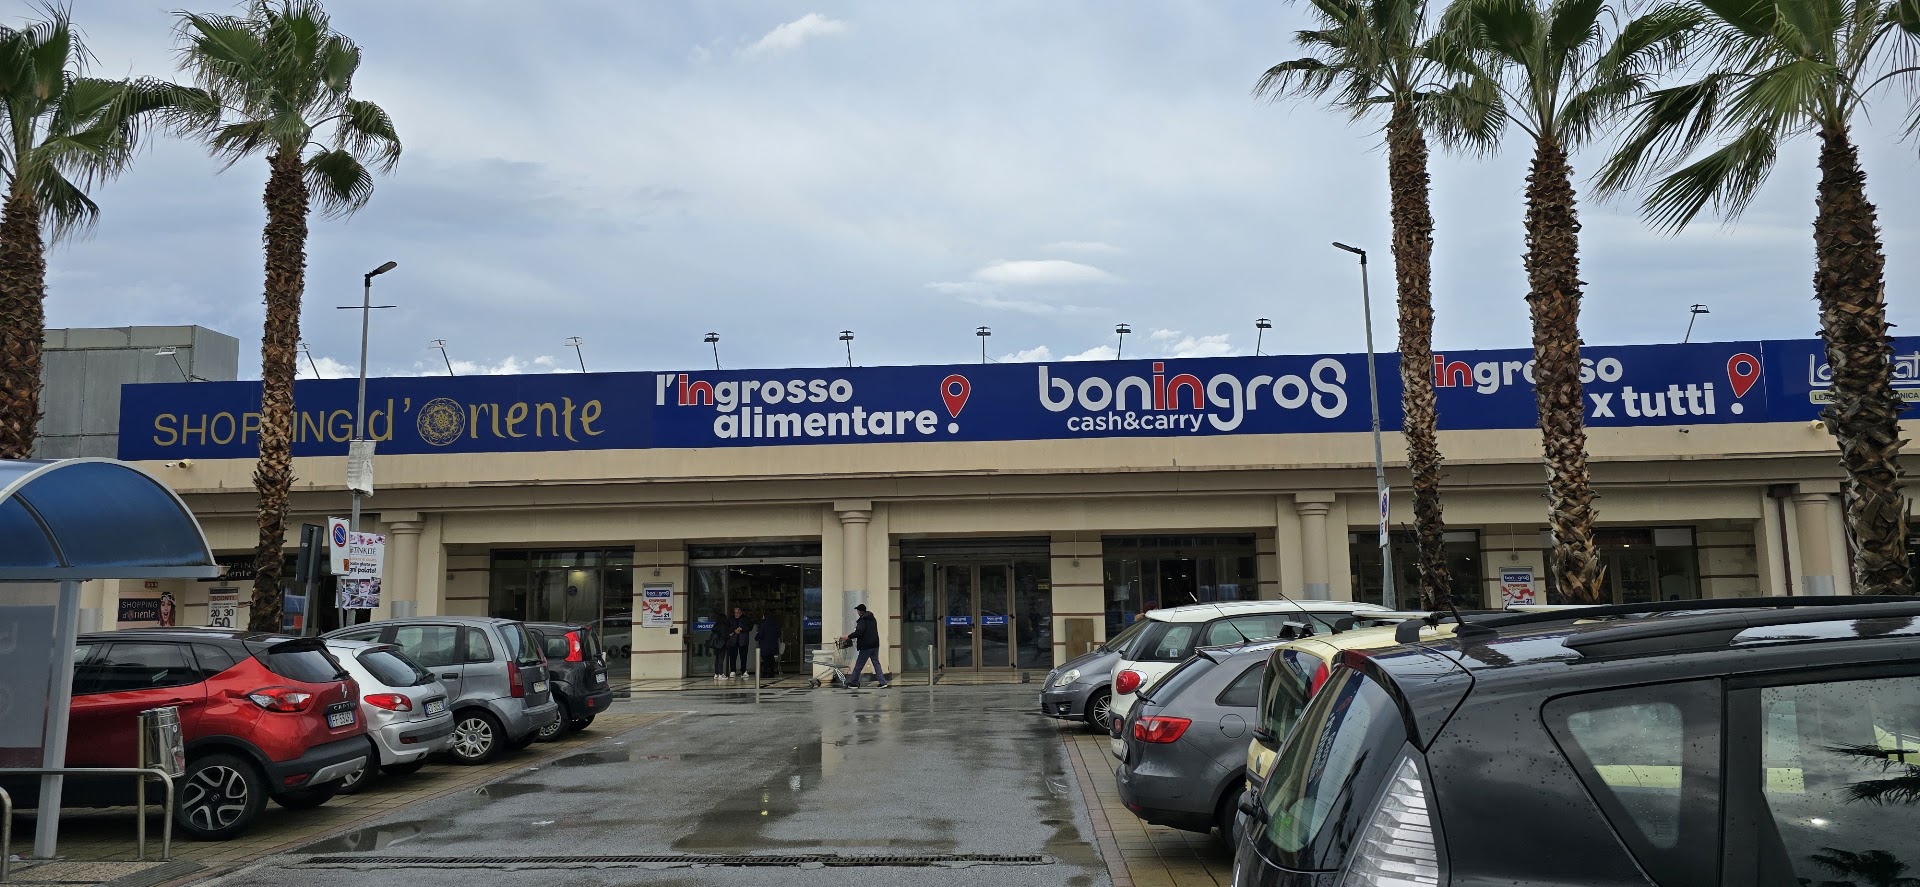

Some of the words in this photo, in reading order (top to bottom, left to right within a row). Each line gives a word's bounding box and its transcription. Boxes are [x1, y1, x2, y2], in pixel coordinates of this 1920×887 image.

[656, 373, 853, 412] l'ingrosso
[1588, 392, 1616, 418] x
[1621, 382, 1716, 418] tutti
[153, 409, 354, 446] SHOPING
[713, 406, 938, 438] alimentare
[1067, 411, 1203, 432] cash&carry
[121, 600, 158, 609] SHOPPING
[211, 609, 220, 618] 20
[224, 608, 234, 617] 30
